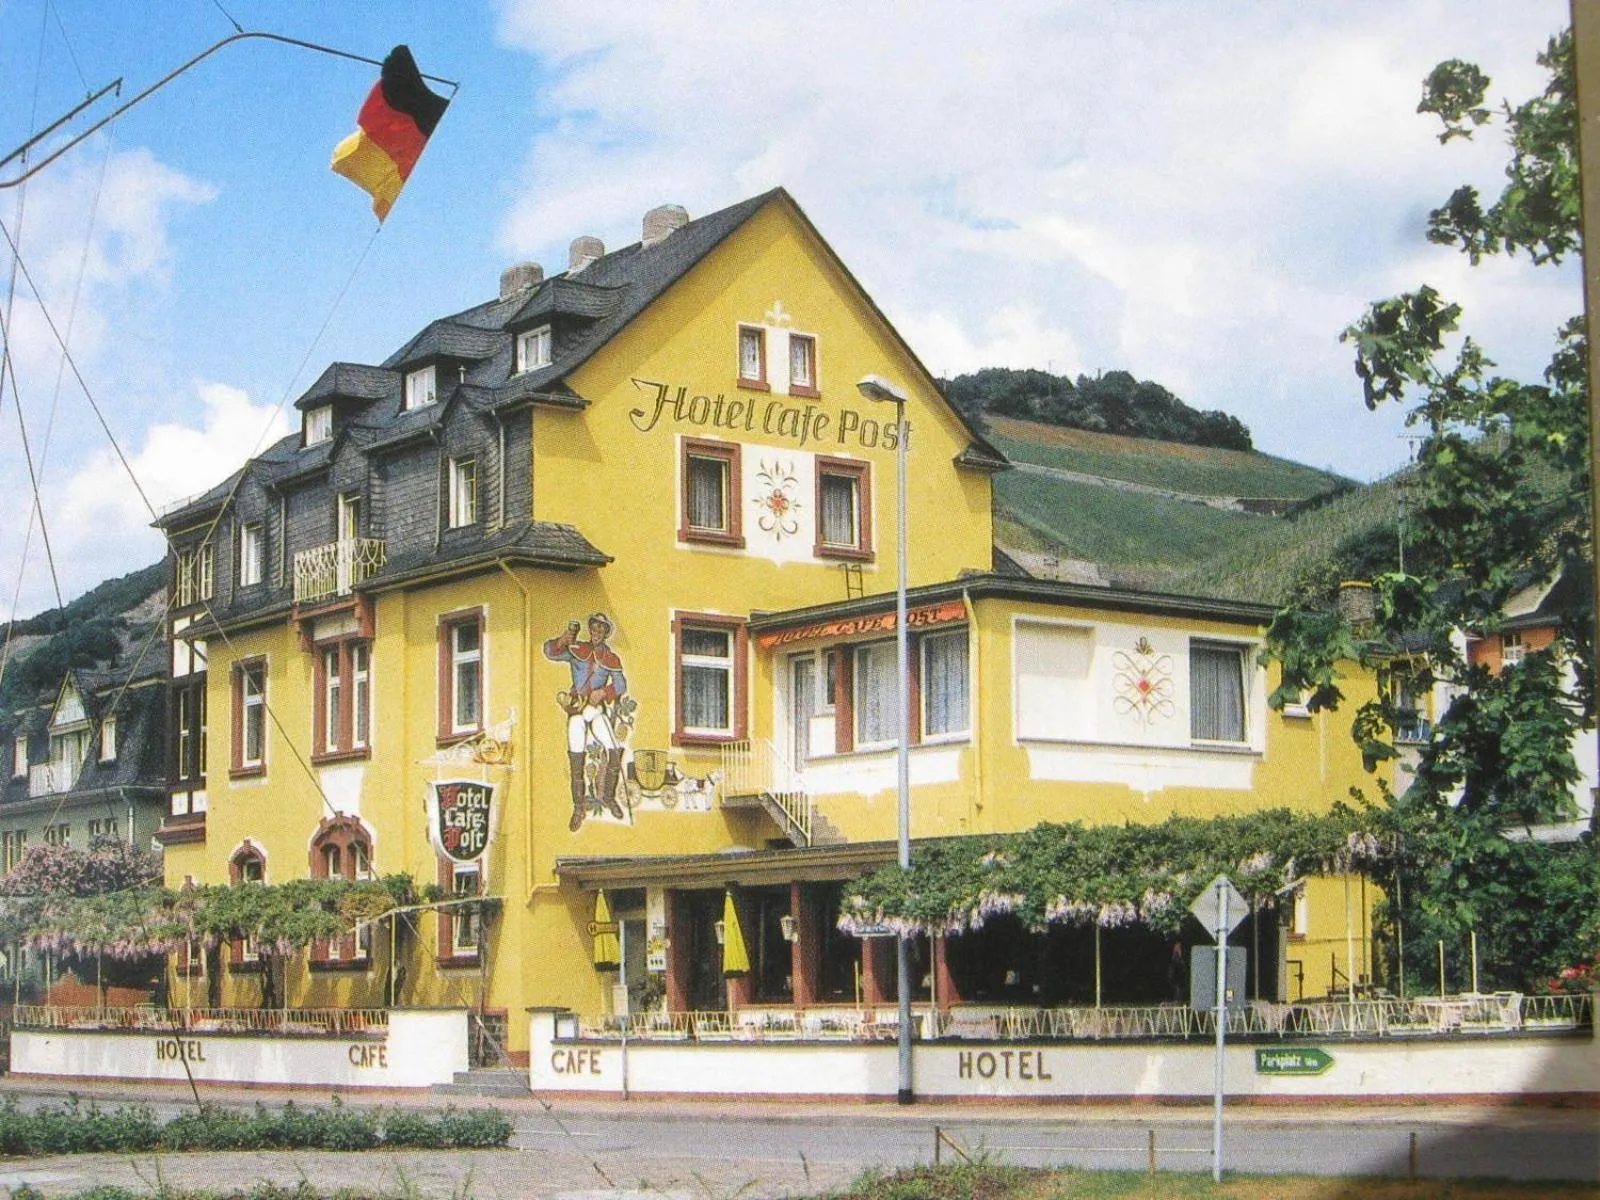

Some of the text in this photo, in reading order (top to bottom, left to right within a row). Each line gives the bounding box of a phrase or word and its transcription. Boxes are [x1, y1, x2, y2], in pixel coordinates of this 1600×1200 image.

[629, 378, 912, 451] Hotel Cafe Post
[157, 1040, 206, 1061] HOTEL
[349, 1044, 388, 1068] CAFE
[551, 1049, 602, 1075] CAFE
[959, 1051, 1052, 1080] HOTEL
